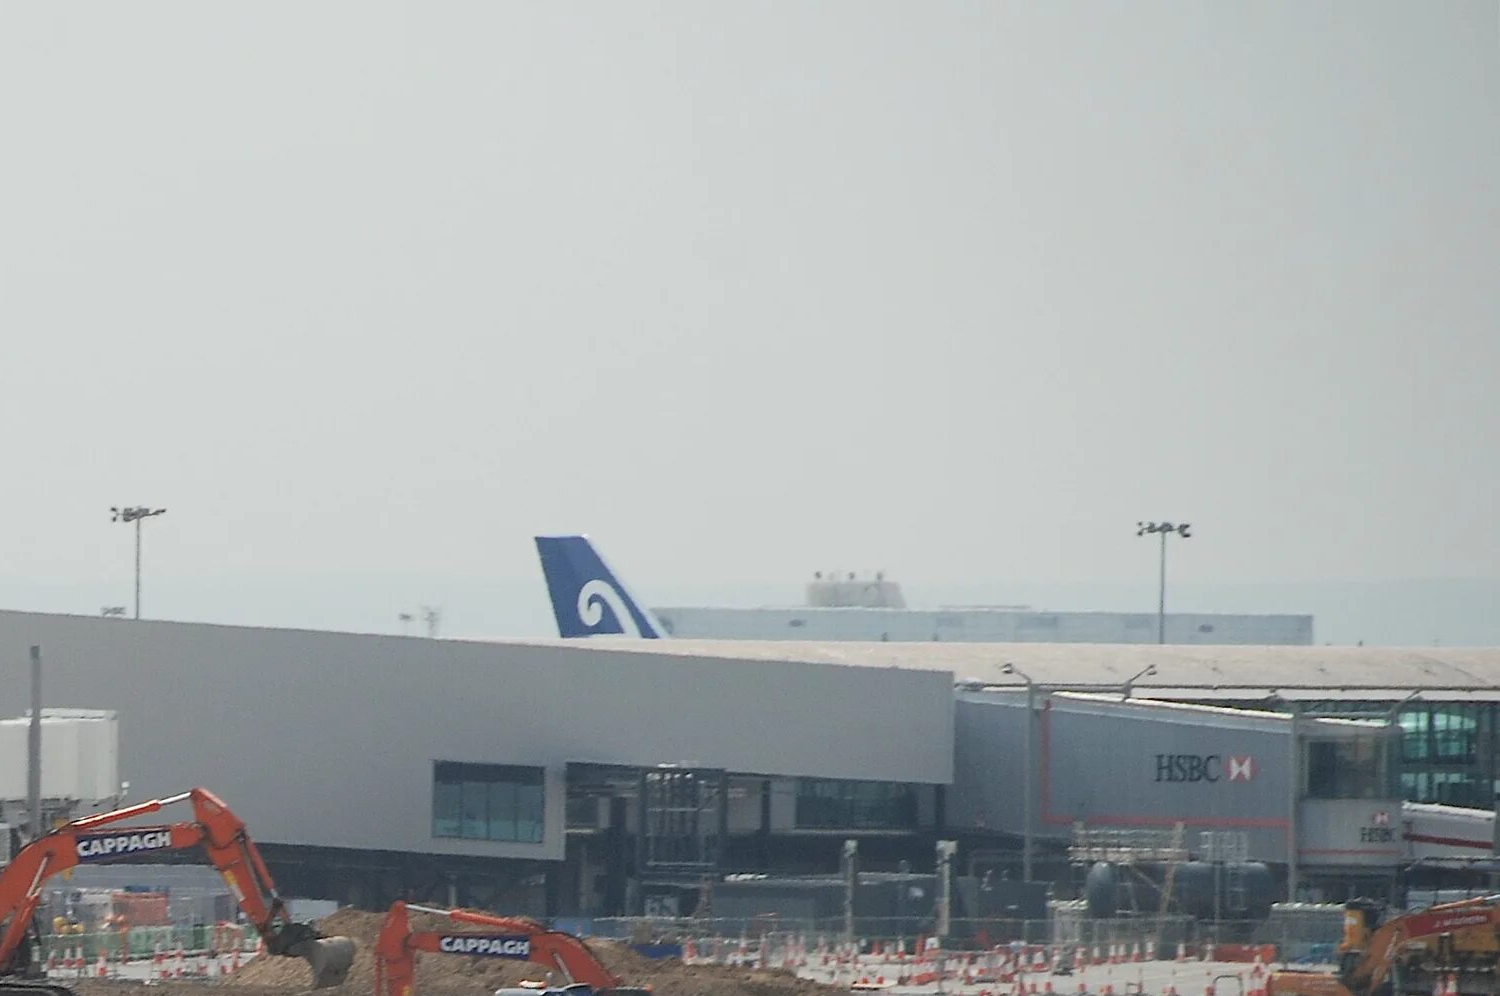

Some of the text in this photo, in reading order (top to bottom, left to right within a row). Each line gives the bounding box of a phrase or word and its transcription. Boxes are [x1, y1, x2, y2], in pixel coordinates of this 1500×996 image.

[1155, 754, 1221, 782] HSBC
[77, 831, 171, 856] CAPPAGH
[441, 936, 530, 954] CAPPAGH
